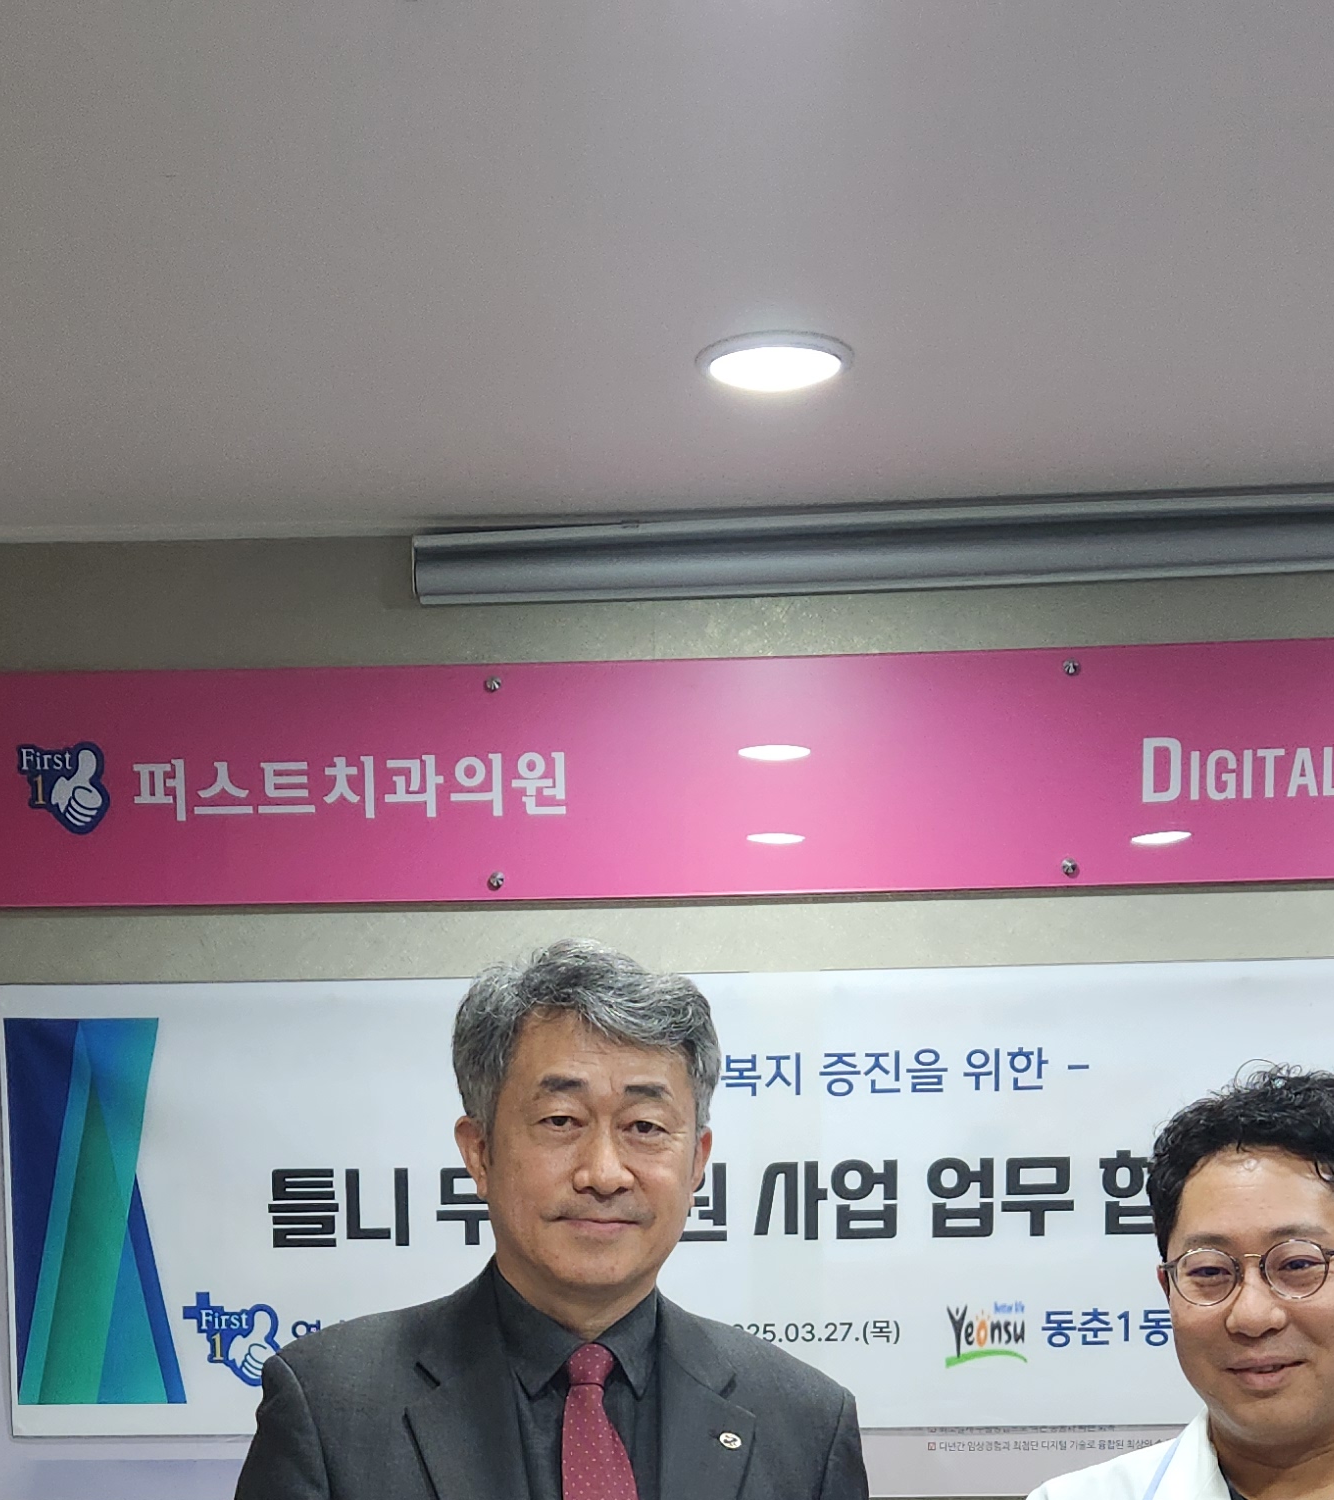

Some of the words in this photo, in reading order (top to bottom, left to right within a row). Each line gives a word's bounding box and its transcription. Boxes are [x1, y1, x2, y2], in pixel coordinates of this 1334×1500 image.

[20, 748, 73, 772] First
[133, 751, 567, 822] 퍼스트치과의원
[721, 1052, 802, 1097] 복지
[819, 1047, 949, 1097] 증진을
[962, 1046, 1050, 1092] 위한
[268, 1167, 410, 1248] 틀니
[436, 1167, 495, 1246] 무
[754, 1157, 898, 1240] 사업
[926, 1155, 1075, 1238] 업무
[1099, 1150, 1156, 1236] 협
[199, 1309, 250, 1331] First
[946, 1303, 1026, 1358] Yeonsu
[1041, 1308, 1174, 1348] 동춘1동
[1041, 1440, 1067, 1451] 디지털
